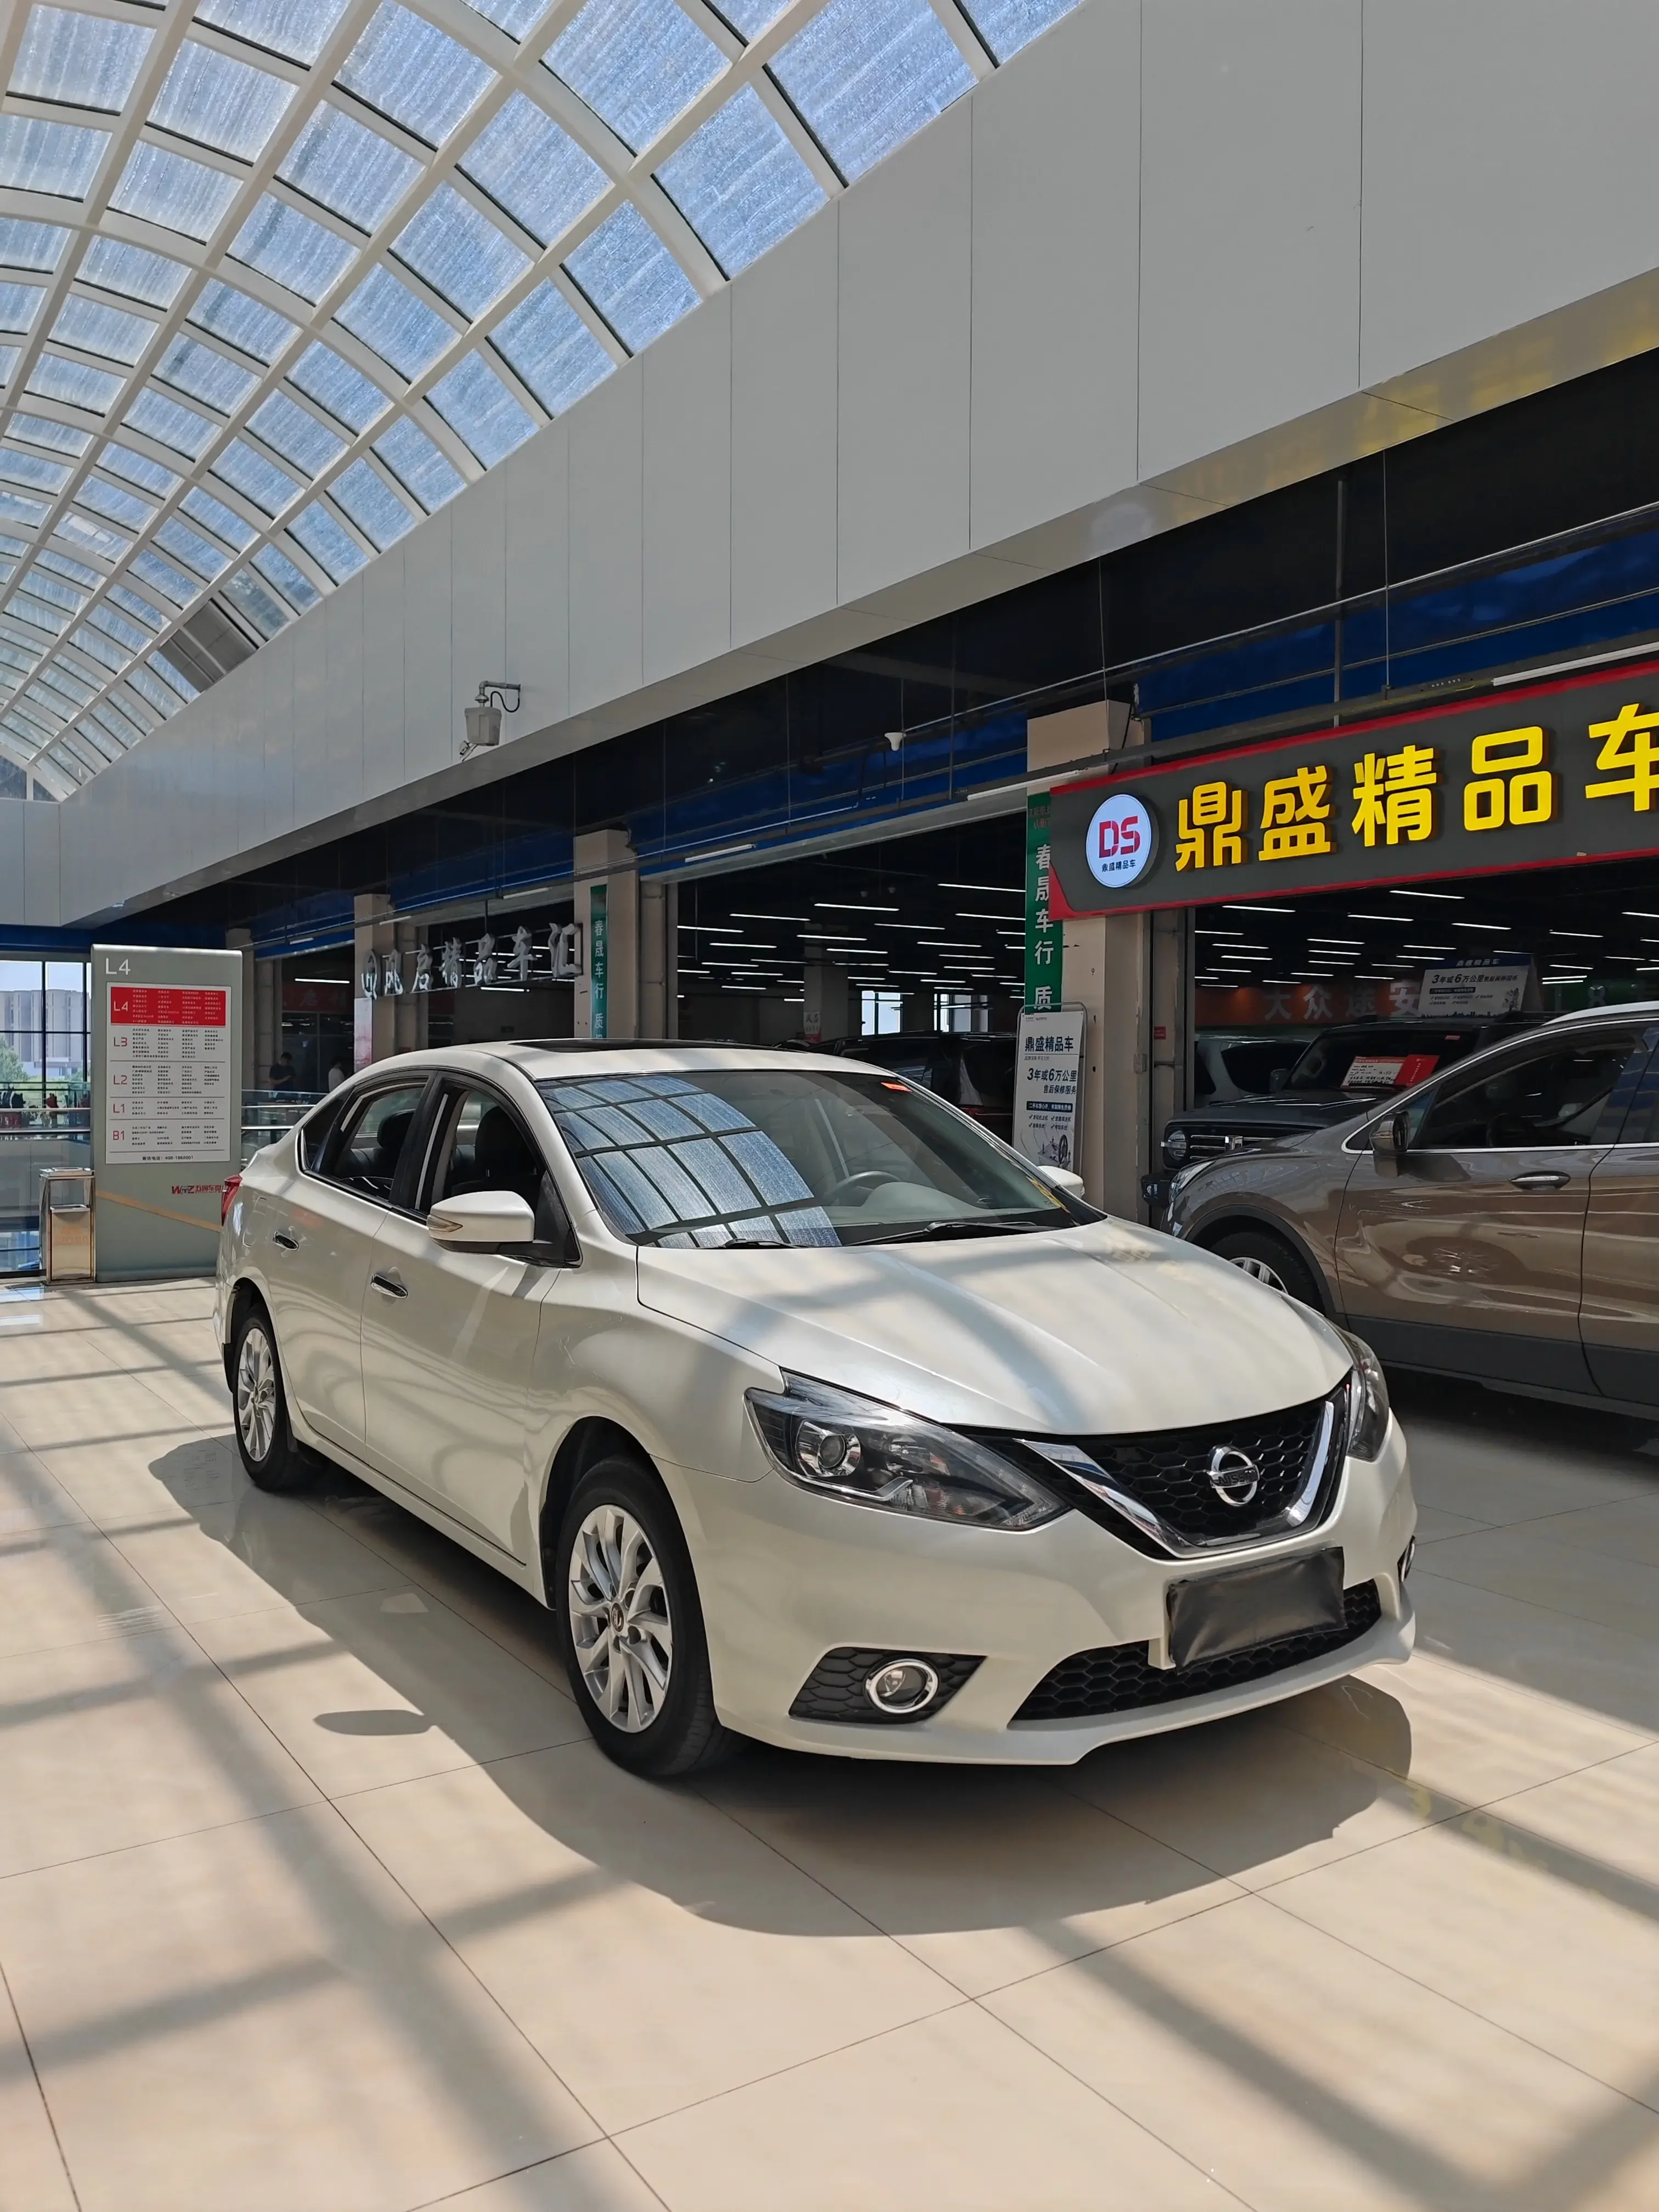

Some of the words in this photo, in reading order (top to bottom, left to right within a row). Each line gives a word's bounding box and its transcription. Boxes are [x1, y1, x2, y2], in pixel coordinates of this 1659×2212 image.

[1175, 703, 1659, 872] 鼎盛精品车
[1099, 815, 1141, 859] DS
[1102, 859, 1136, 873] 鼎盛精品车
[594, 919, 604, 999] 春晟车行
[106, 958, 131, 975] L4
[114, 1001, 128, 1012] L4
[114, 1036, 128, 1047] L3
[1024, 1036, 1074, 1052] 鼎盛精品车
[113, 1075, 127, 1085] L2
[1026, 1068, 1077, 1082] 3年或6万公里
[1043, 1085, 1076, 1095] 售后保修服务
[113, 1103, 125, 1113] L1
[112, 1130, 125, 1141] B1
[1218, 1469, 1257, 1486] NISSAN
